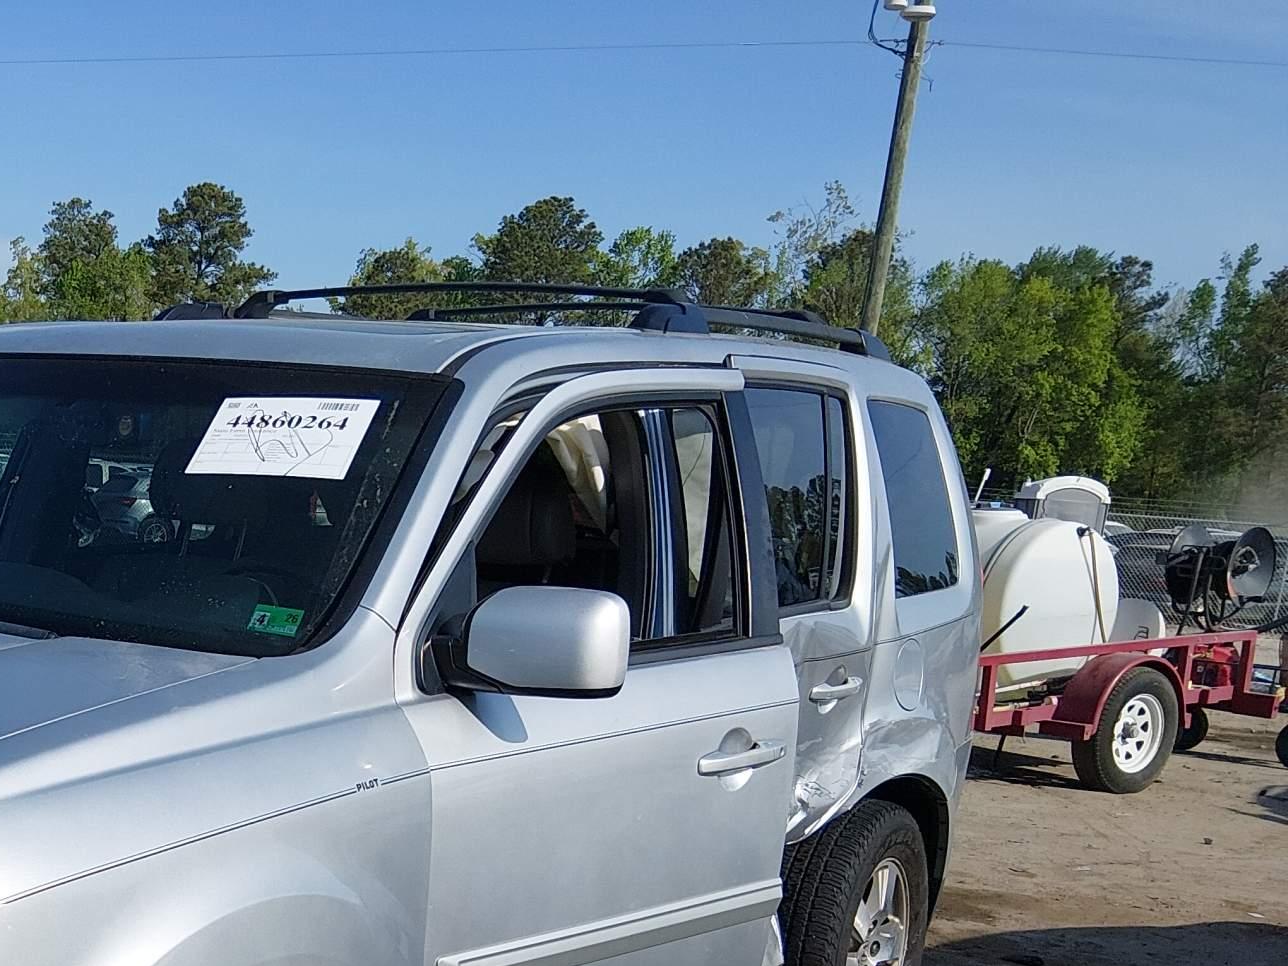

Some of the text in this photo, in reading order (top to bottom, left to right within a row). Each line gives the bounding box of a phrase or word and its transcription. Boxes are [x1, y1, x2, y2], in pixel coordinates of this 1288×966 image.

[226, 414, 350, 430] 44860264
[256, 613, 267, 625] 4
[355, 778, 379, 792] PILOT
